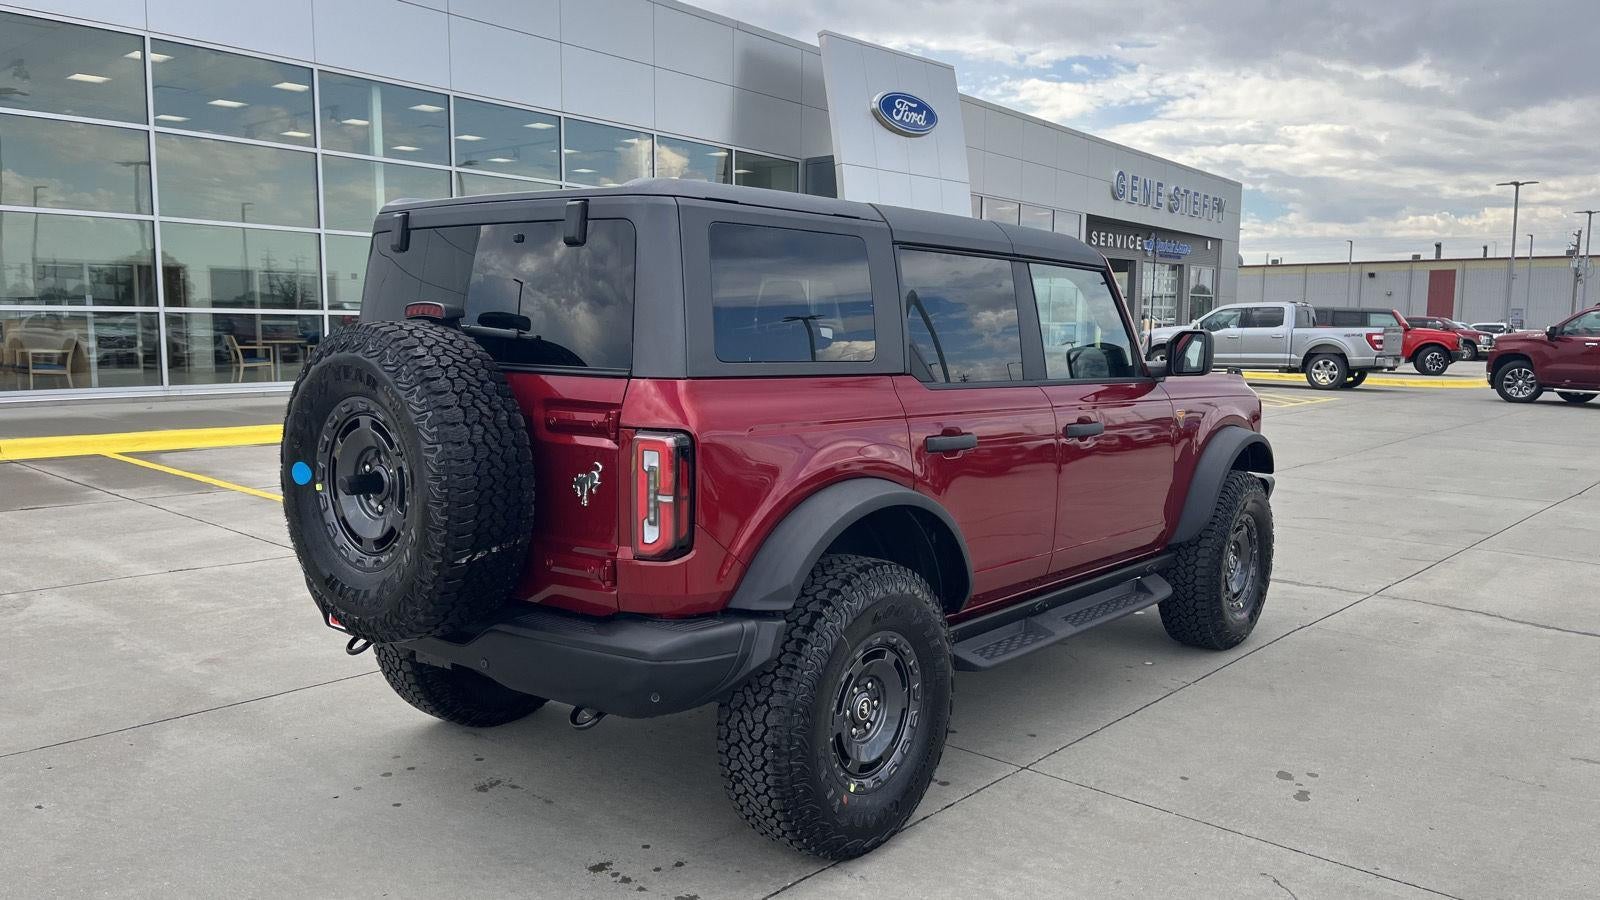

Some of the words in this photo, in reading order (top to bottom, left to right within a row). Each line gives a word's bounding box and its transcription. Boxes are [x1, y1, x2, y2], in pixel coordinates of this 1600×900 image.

[892, 98, 927, 126] Ford
[1114, 170, 1164, 209] GENE
[1169, 186, 1226, 222] STEFFY
[1091, 230, 1142, 250] SERVICE
